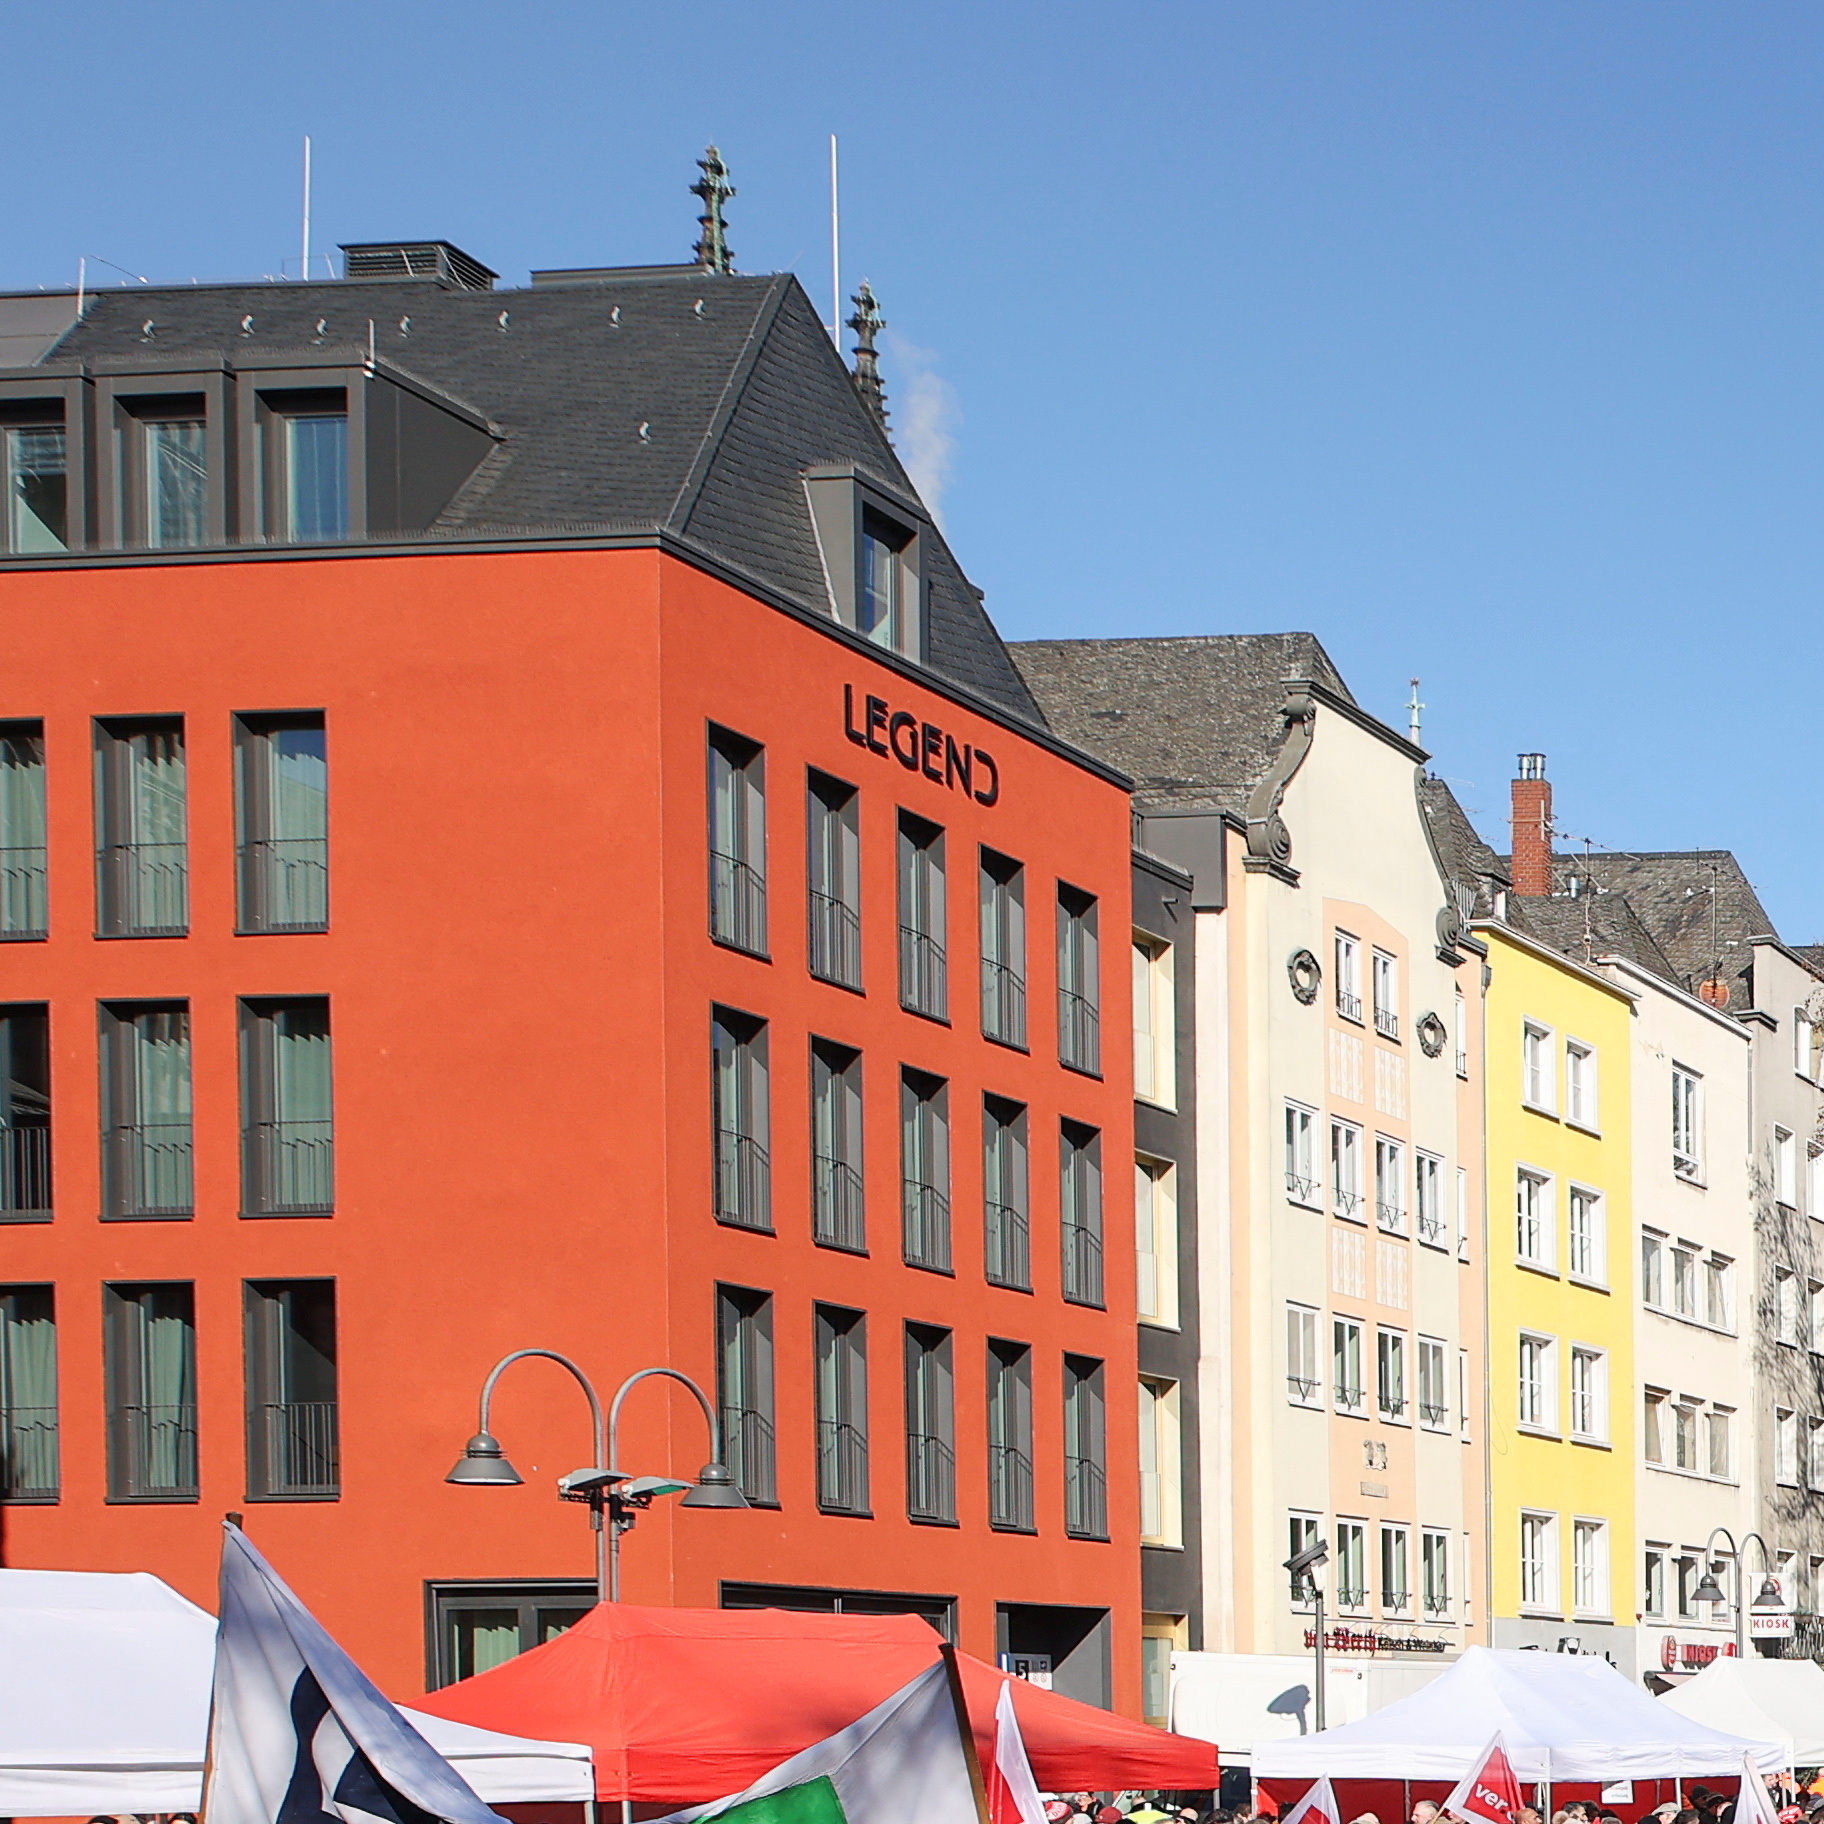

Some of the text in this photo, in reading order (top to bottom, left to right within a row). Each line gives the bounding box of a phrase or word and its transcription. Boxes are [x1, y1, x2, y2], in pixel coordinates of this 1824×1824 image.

[844, 682, 999, 808] LEGEND
[1753, 1618, 1790, 1631] KIOSK
[1016, 1660, 1028, 1680] 5
